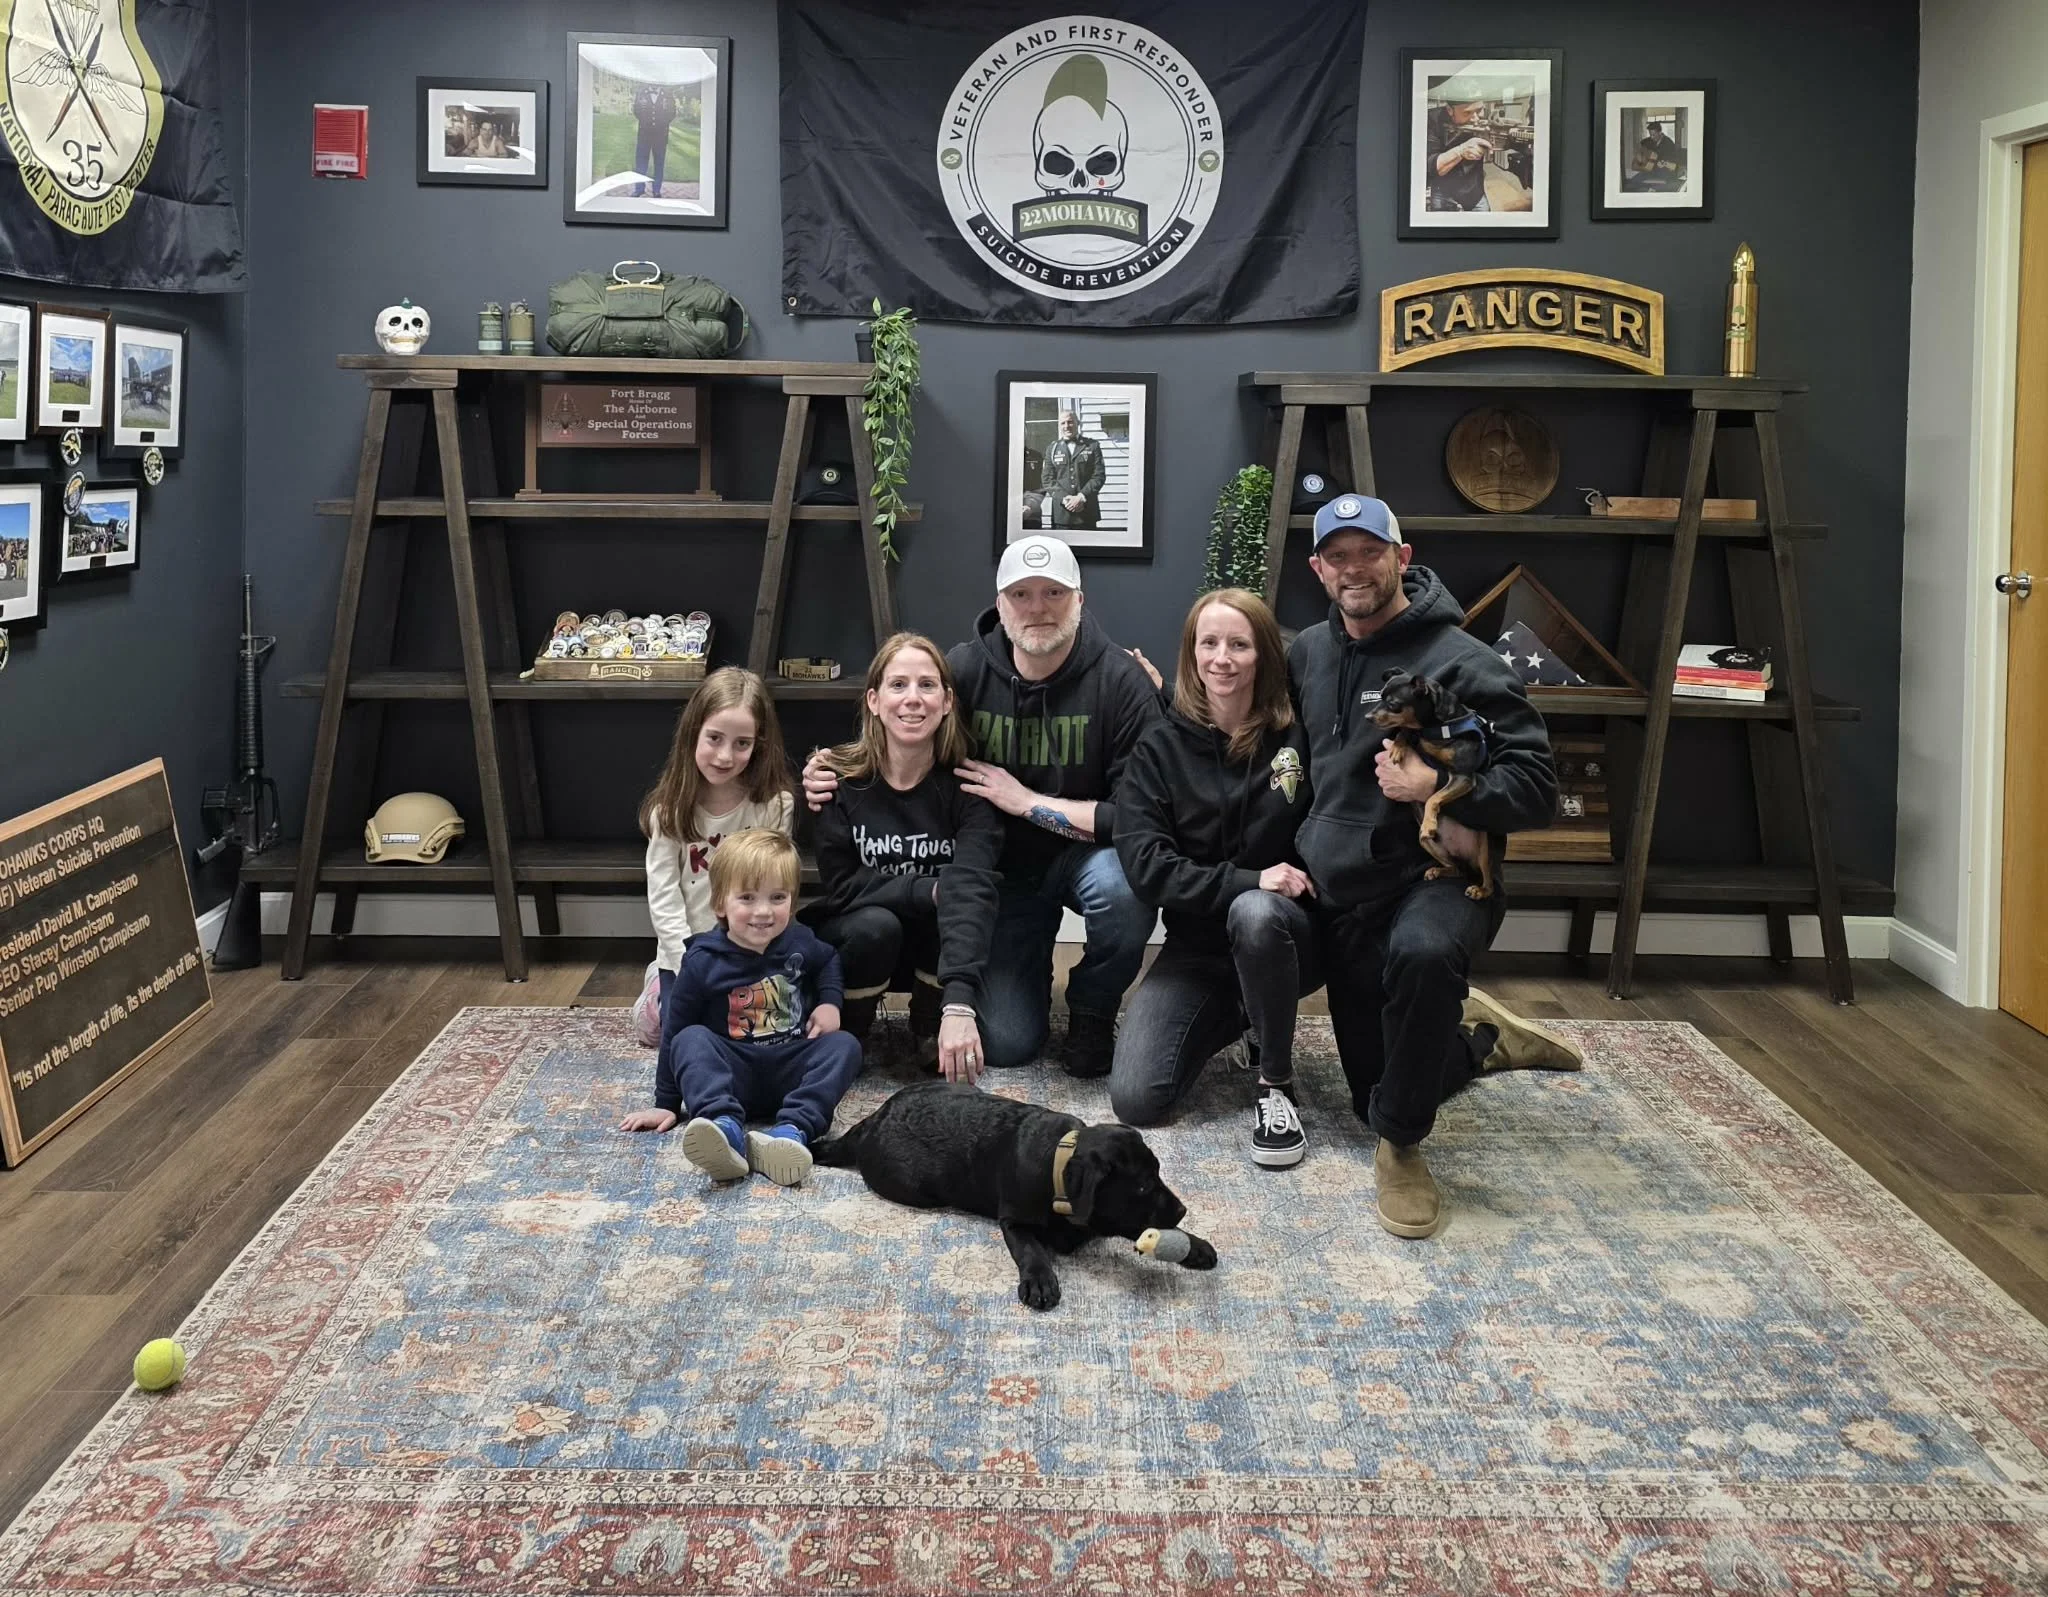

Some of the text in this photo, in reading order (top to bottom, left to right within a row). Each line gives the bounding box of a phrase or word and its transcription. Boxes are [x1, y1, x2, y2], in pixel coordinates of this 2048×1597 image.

[950, 25, 1213, 142] VETERAN AND FIRST RESPONDER
[0, 101, 47, 195] NATIONAL
[43, 185, 103, 229] PARACHUTE
[105, 187, 127, 222] TEST
[62, 139, 104, 191] 35
[1020, 204, 1138, 230] 22MOHAWKS
[977, 225, 1183, 286] SUICIDE PREVENTION
[1404, 290, 1644, 346] RANGER
[603, 404, 678, 414] The Airborne
[611, 389, 671, 401] Fort Bragg
[587, 420, 692, 431] Special Operations
[622, 430, 659, 439] Forces
[604, 667, 638, 676] RANGER
[971, 710, 1089, 766] PATRIOT
[14, 867, 57, 898] Veteran
[56, 848, 93, 877] Suicide
[93, 825, 142, 859] Prevention
[48, 824, 87, 855] CORPS
[88, 816, 105, 837] HQ
[853, 825, 903, 857] HANG
[42, 905, 73, 936] David
[72, 899, 87, 920] M.
[86, 873, 139, 911] Campisano
[0, 914, 151, 1017] Senior Pup Winston Campisano
[20, 943, 59, 975] Stacey
[59, 911, 115, 952] Campisano
[34, 1055, 53, 1080] not
[50, 1045, 70, 1067] the
[69, 1021, 100, 1054] length
[99, 1011, 111, 1032] of
[110, 1003, 128, 1026] life,
[126, 994, 139, 1013] its
[138, 984, 154, 1005] the
[153, 966, 177, 992] depth
[176, 958, 186, 978] of
